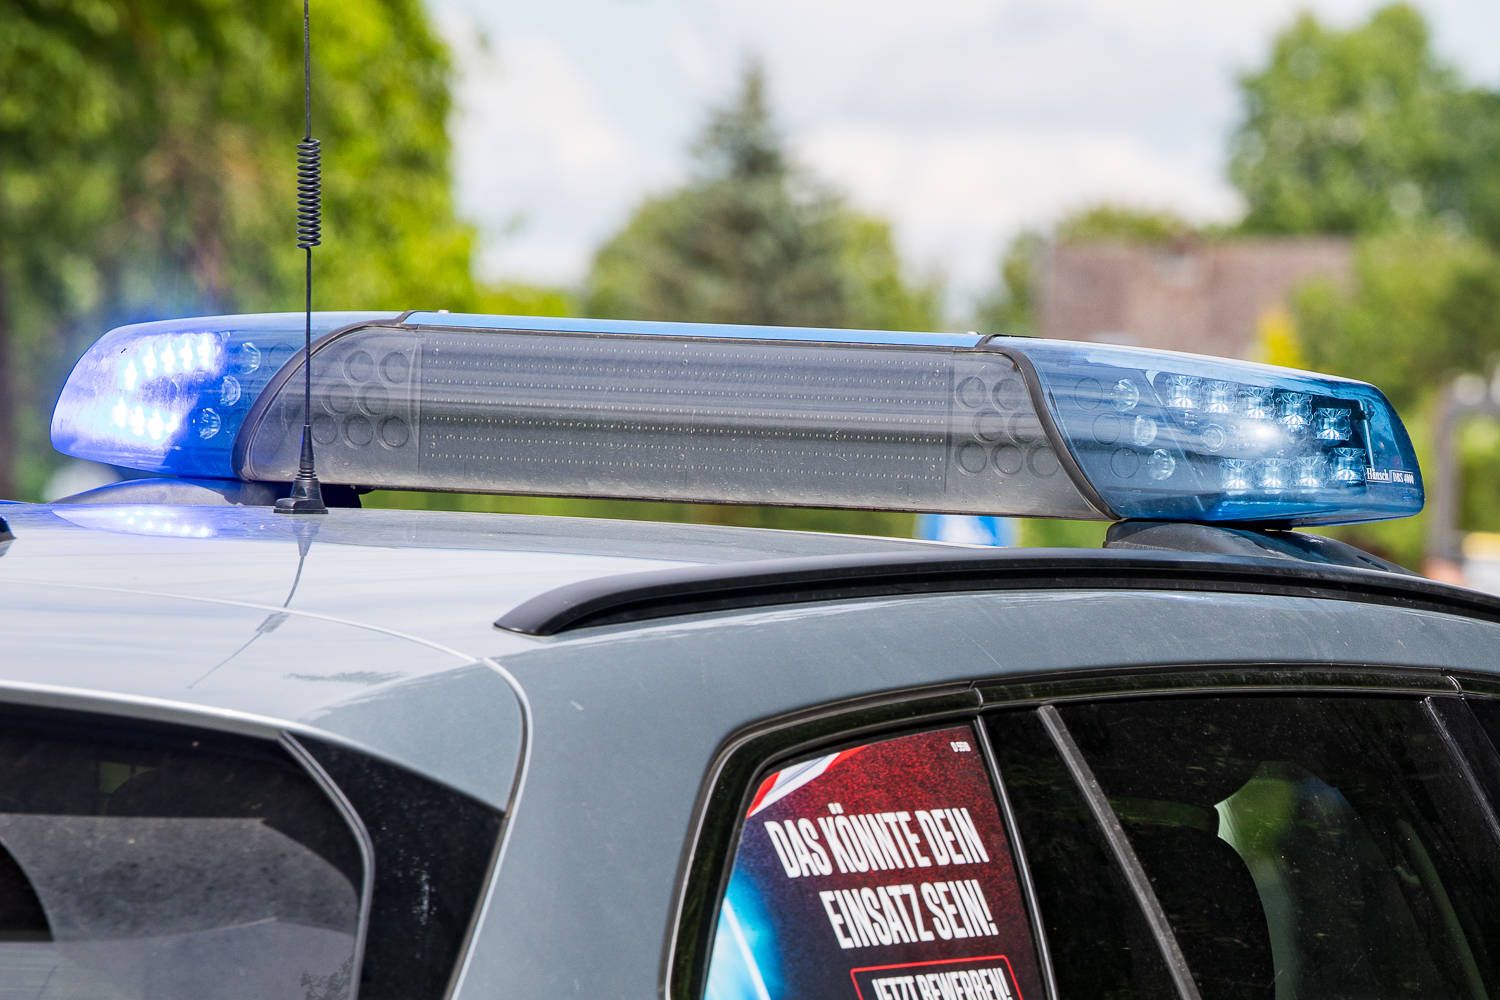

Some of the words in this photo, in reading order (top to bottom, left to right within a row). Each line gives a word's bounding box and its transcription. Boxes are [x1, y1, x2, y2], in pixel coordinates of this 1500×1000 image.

[764, 818, 833, 879] DAS
[817, 803, 932, 874] KÖNNTE
[914, 807, 990, 866] DEIN
[818, 884, 935, 950] EINSATZ
[920, 878, 999, 942] SEIN!
